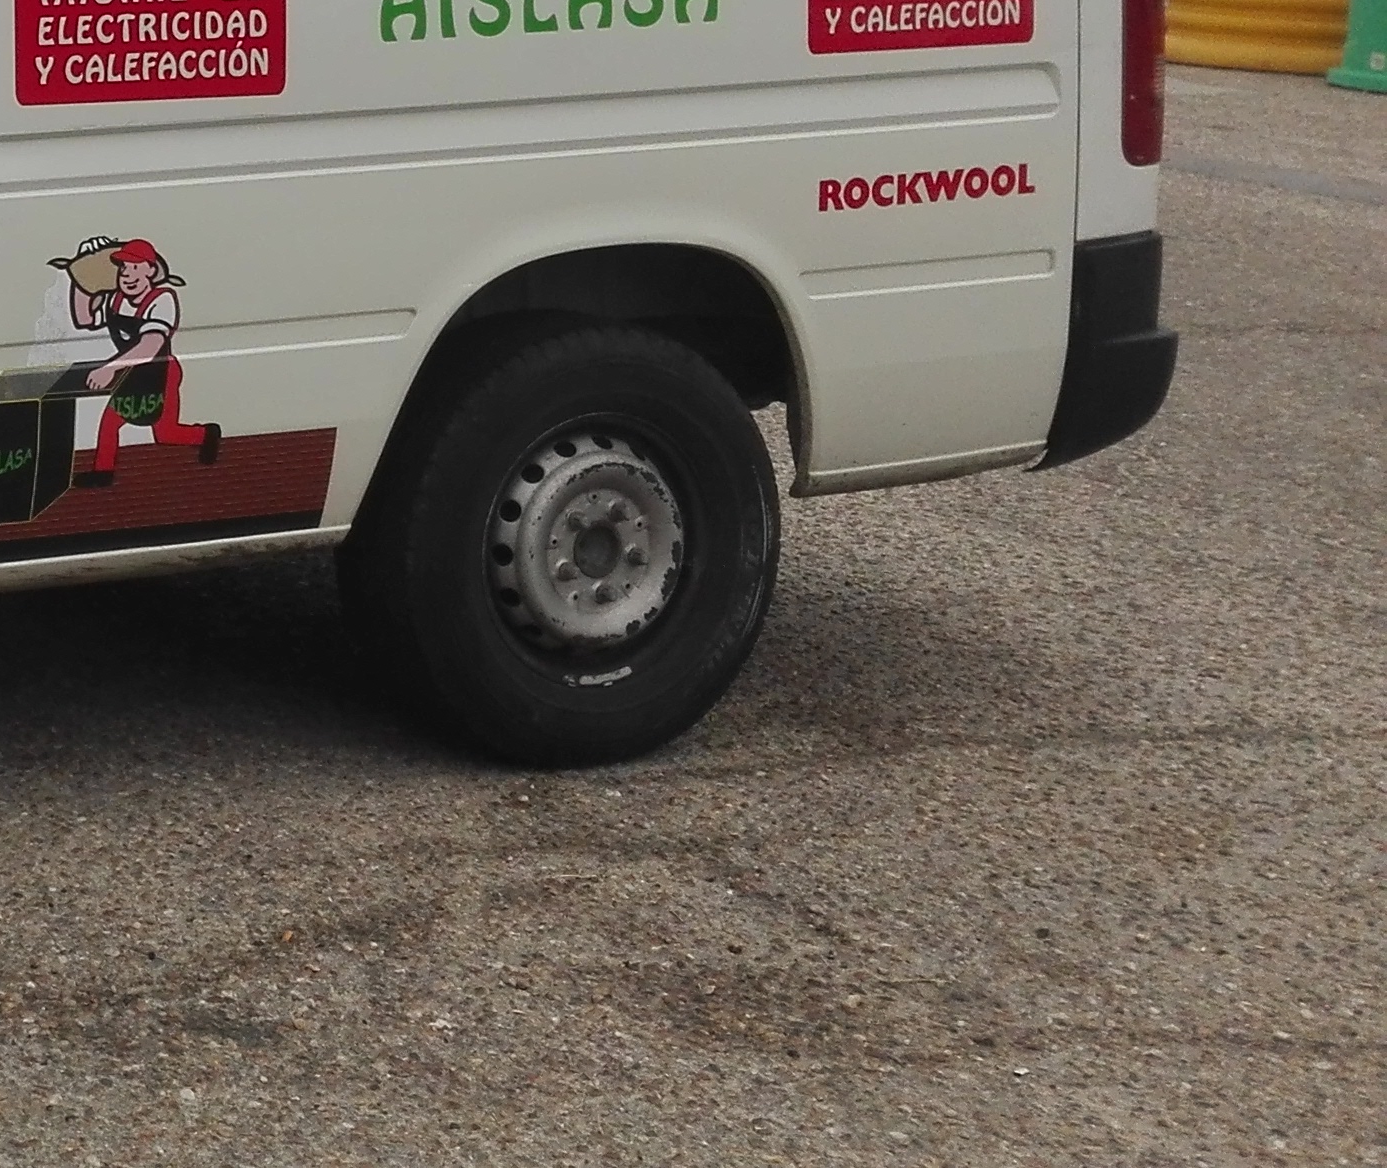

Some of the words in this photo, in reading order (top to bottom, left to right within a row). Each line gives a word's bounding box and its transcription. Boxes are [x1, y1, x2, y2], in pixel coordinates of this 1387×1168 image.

[38, 10, 267, 45] ELECTRICIDAD
[825, 7, 841, 34] Y
[35, 57, 54, 84] Y
[65, 40, 268, 84] CALEFACCIÓN
[819, 164, 1035, 211] ROCKWOOL
